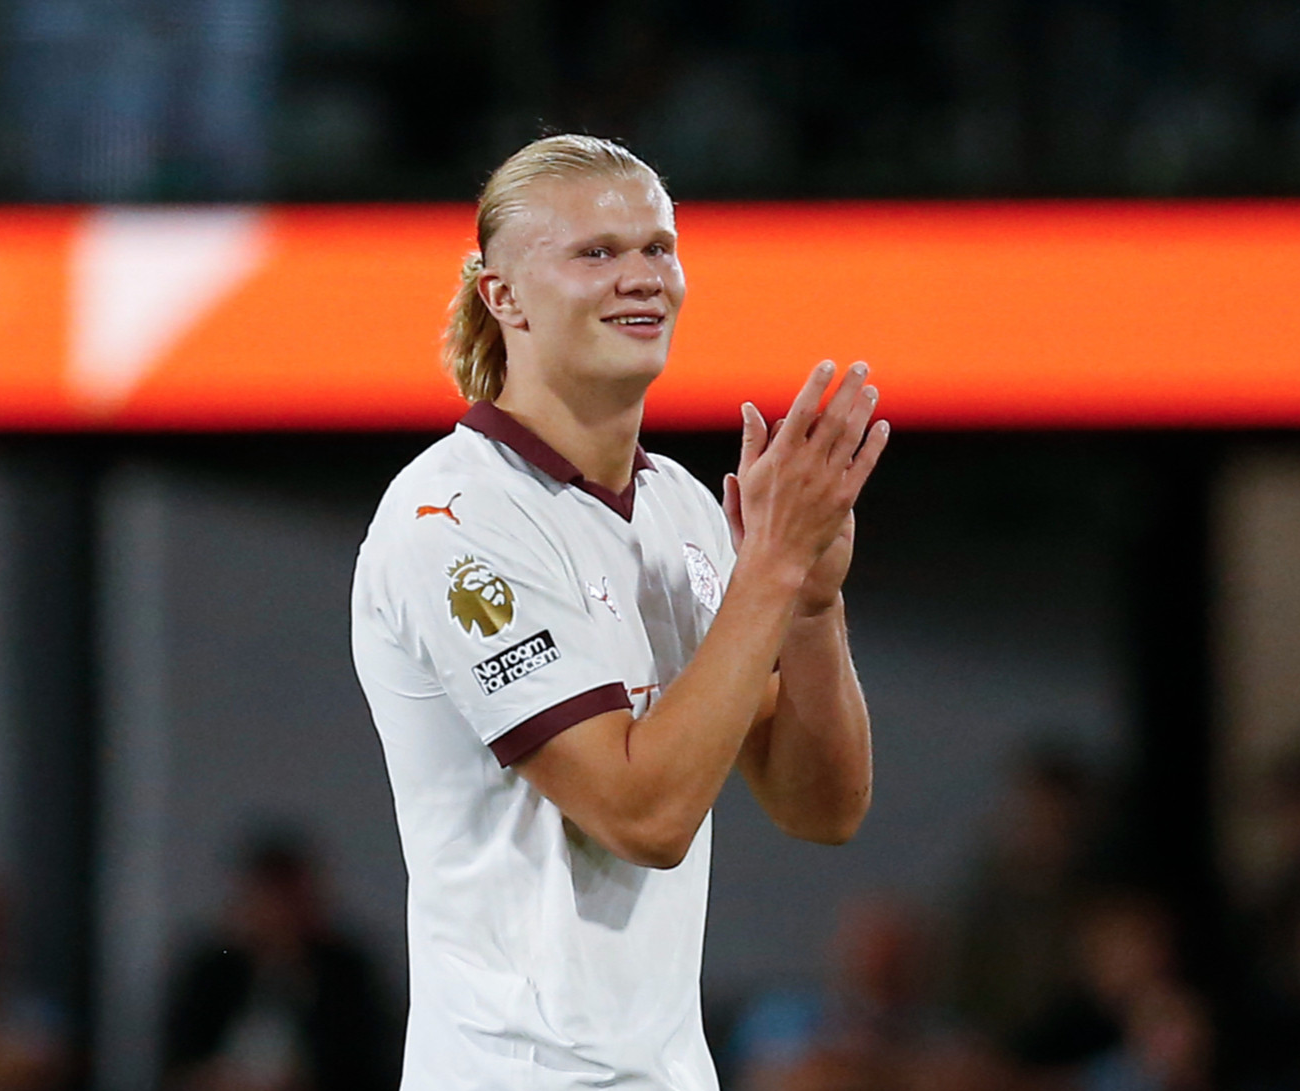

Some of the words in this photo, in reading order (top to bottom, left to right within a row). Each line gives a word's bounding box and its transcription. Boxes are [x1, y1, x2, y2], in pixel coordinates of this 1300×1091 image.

[473, 660, 500, 682] No
[500, 637, 547, 669] room
[479, 672, 505, 695] for
[505, 646, 561, 682] racism
